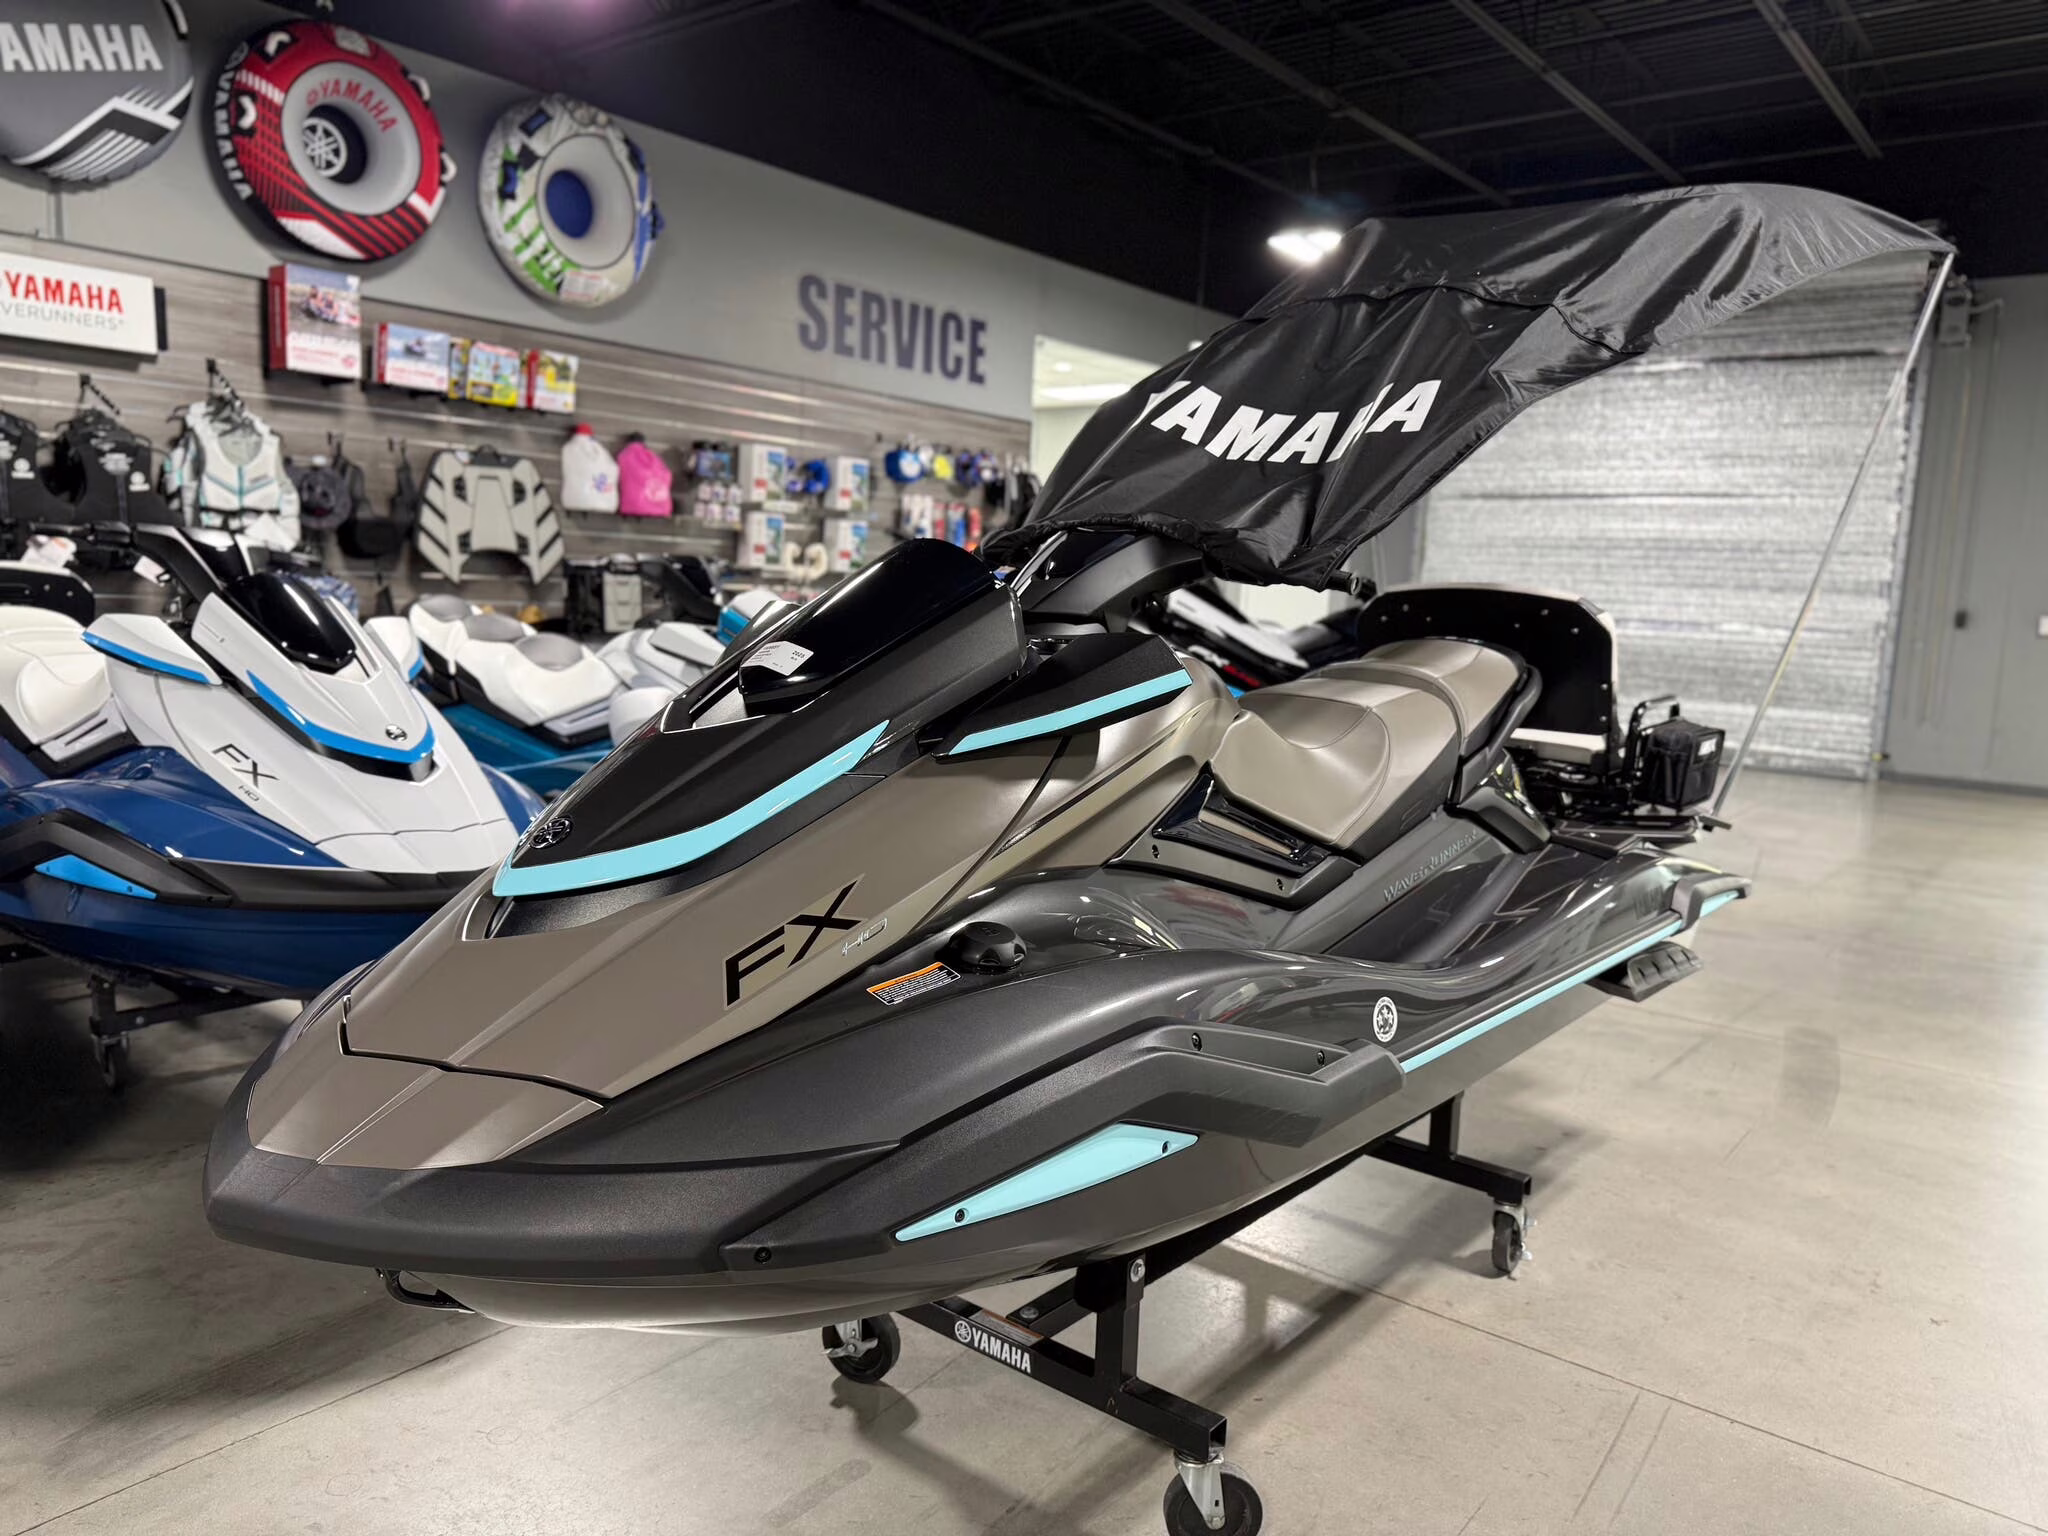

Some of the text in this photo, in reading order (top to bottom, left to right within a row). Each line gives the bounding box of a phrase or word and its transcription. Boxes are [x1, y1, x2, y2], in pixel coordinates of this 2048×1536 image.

[319, 78, 399, 133] YAMAHA
[4, 269, 124, 315] YAMAHA
[797, 273, 988, 385] SERVICE
[212, 743, 281, 788] FX
[724, 877, 863, 1008] FX
[972, 1326, 1032, 1374] YAMAHA
